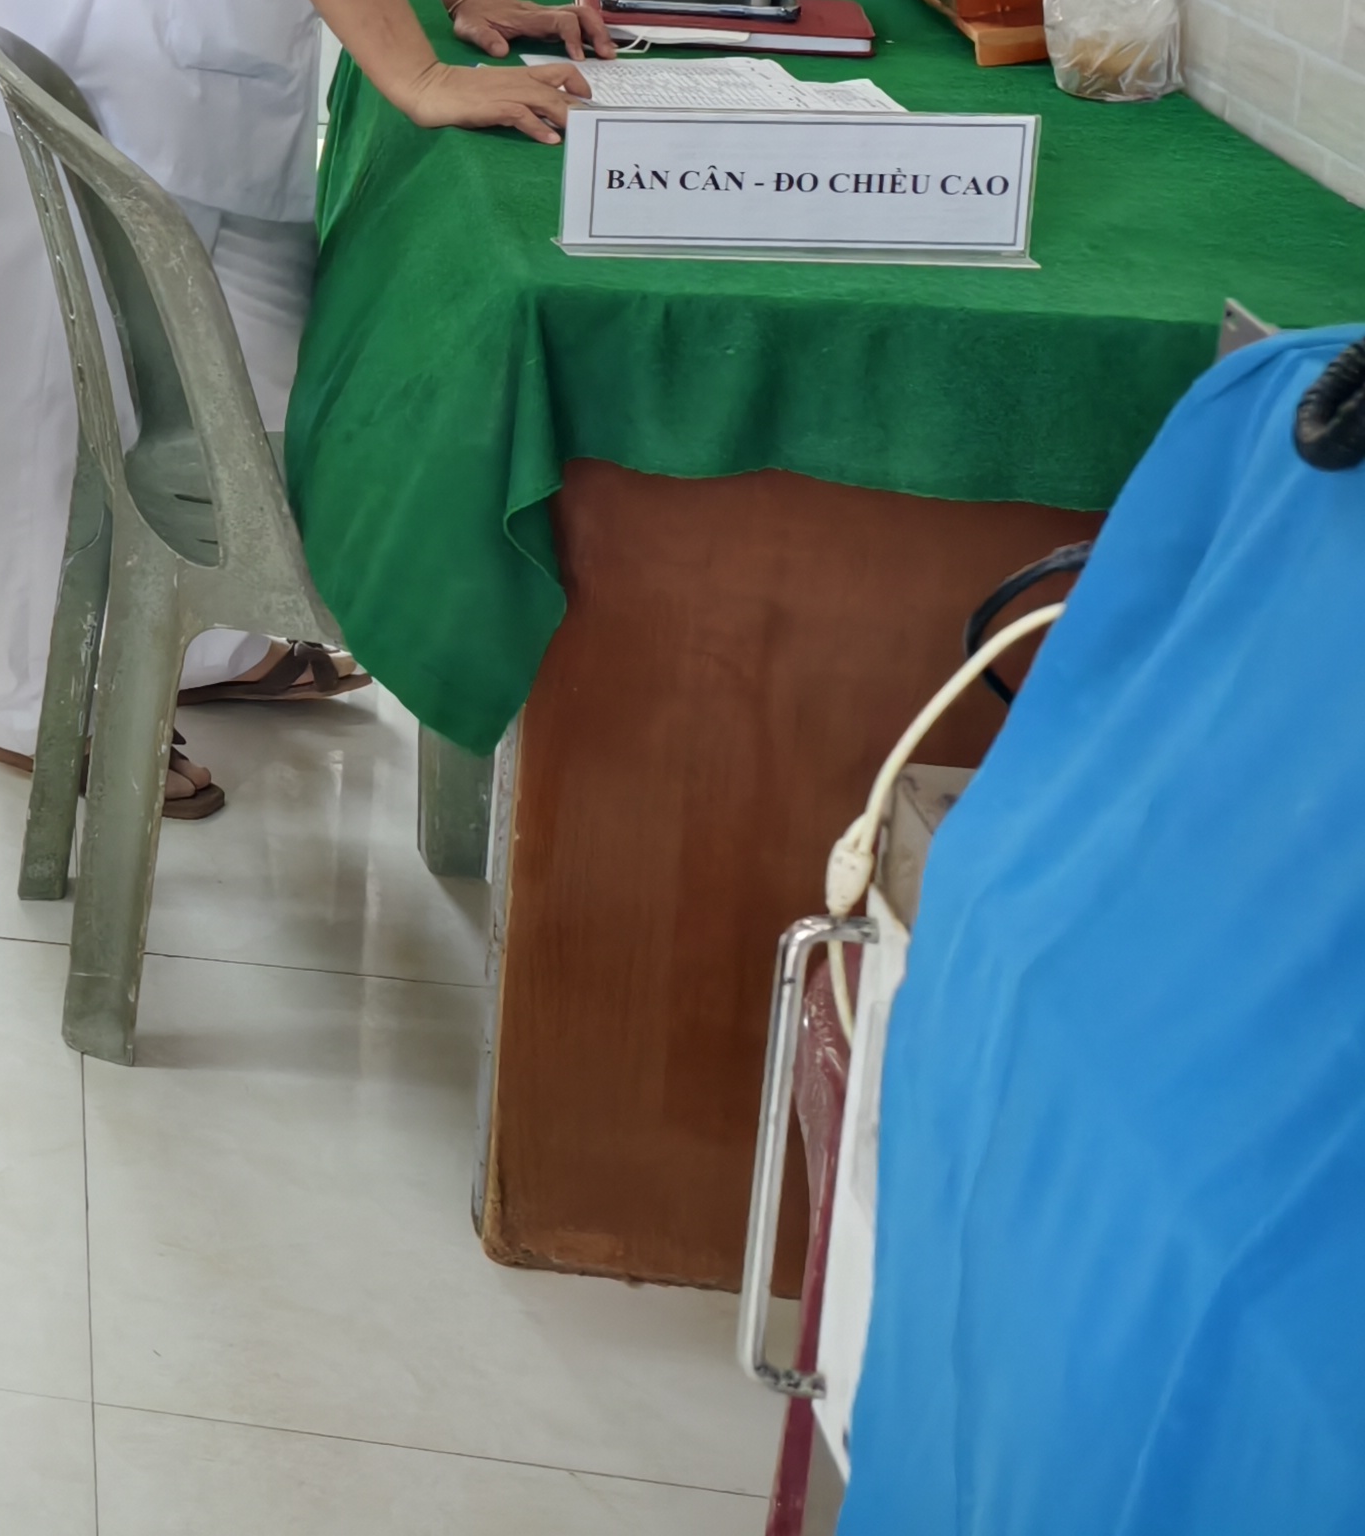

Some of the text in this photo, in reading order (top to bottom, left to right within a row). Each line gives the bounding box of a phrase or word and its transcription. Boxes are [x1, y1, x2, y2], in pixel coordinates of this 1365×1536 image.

[606, 164, 670, 190] BÀN
[679, 165, 746, 191] CÂN
[774, 172, 819, 193] ĐO
[940, 174, 1010, 197] CAO
